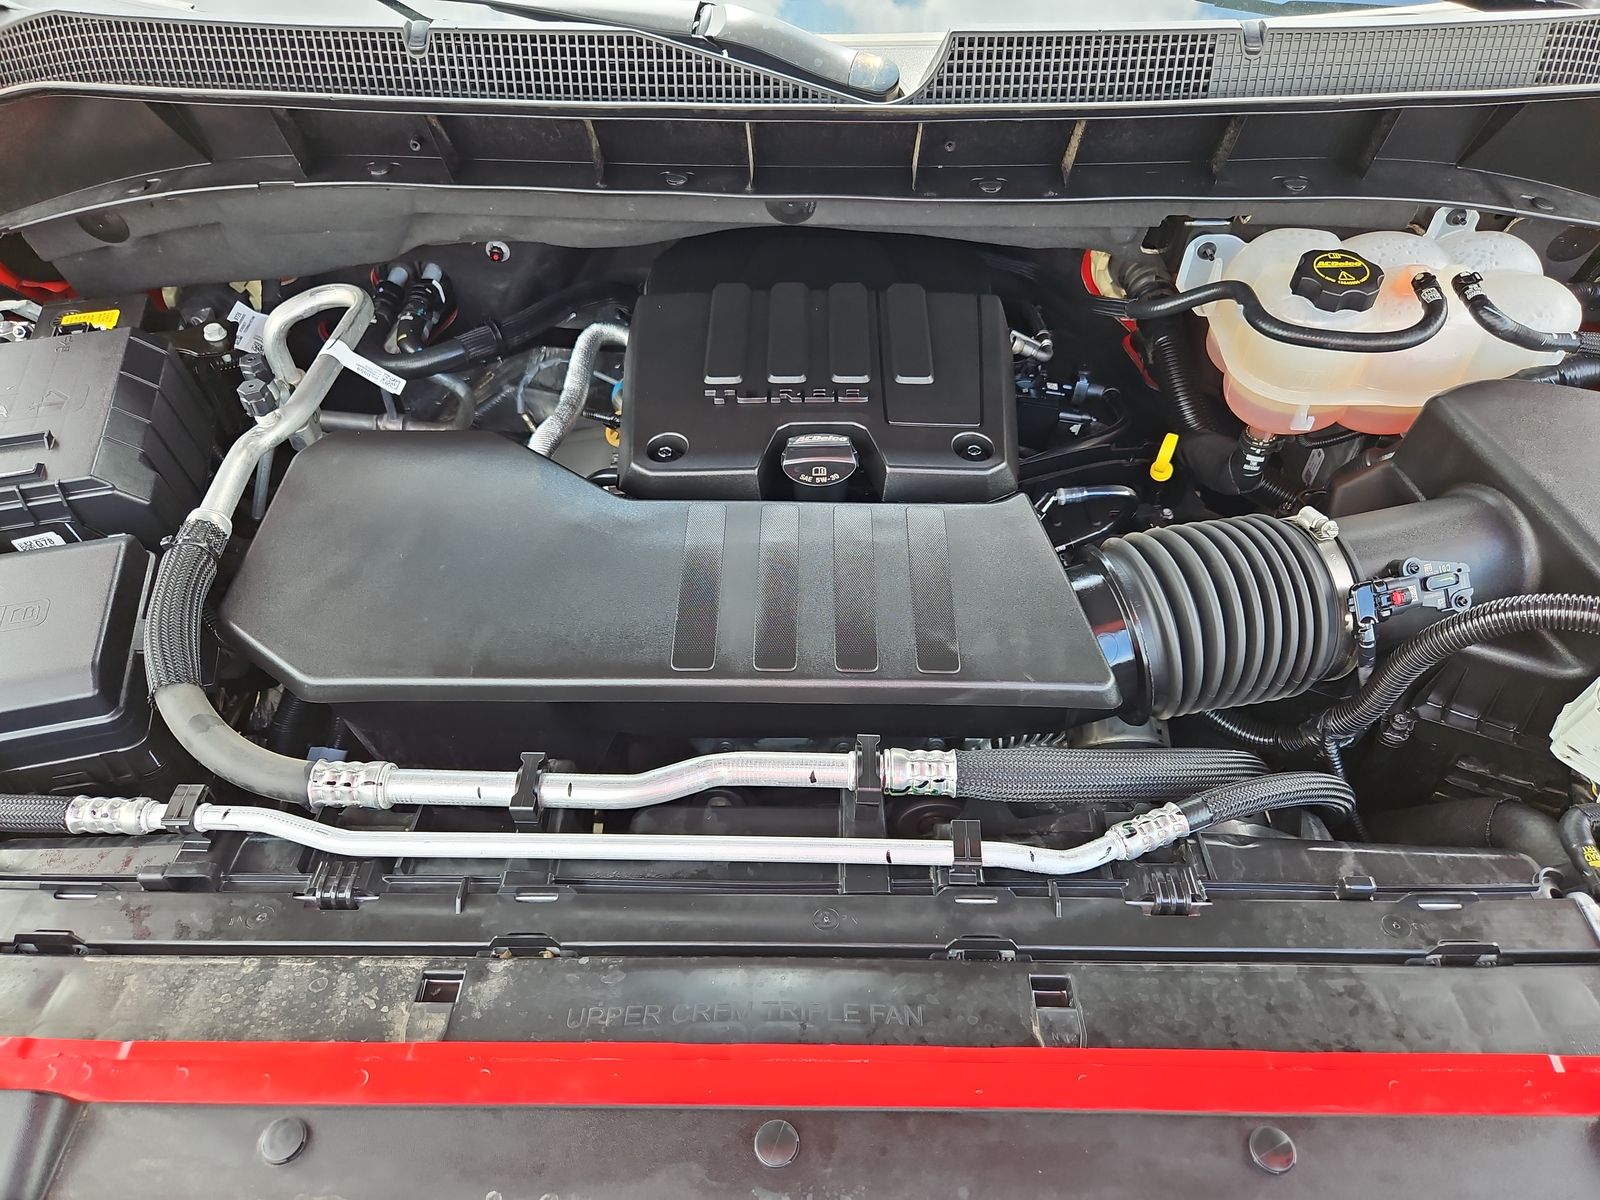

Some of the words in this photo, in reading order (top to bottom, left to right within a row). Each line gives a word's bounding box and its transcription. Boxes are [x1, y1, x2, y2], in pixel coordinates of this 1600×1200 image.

[795, 435, 848, 444] ACDelco
[800, 473, 813, 482] SAE
[815, 473, 840, 483] 5W-30
[566, 1004, 663, 1029] UPPER
[761, 1001, 861, 1023] TRIPLE
[869, 1003, 924, 1027] FAN
